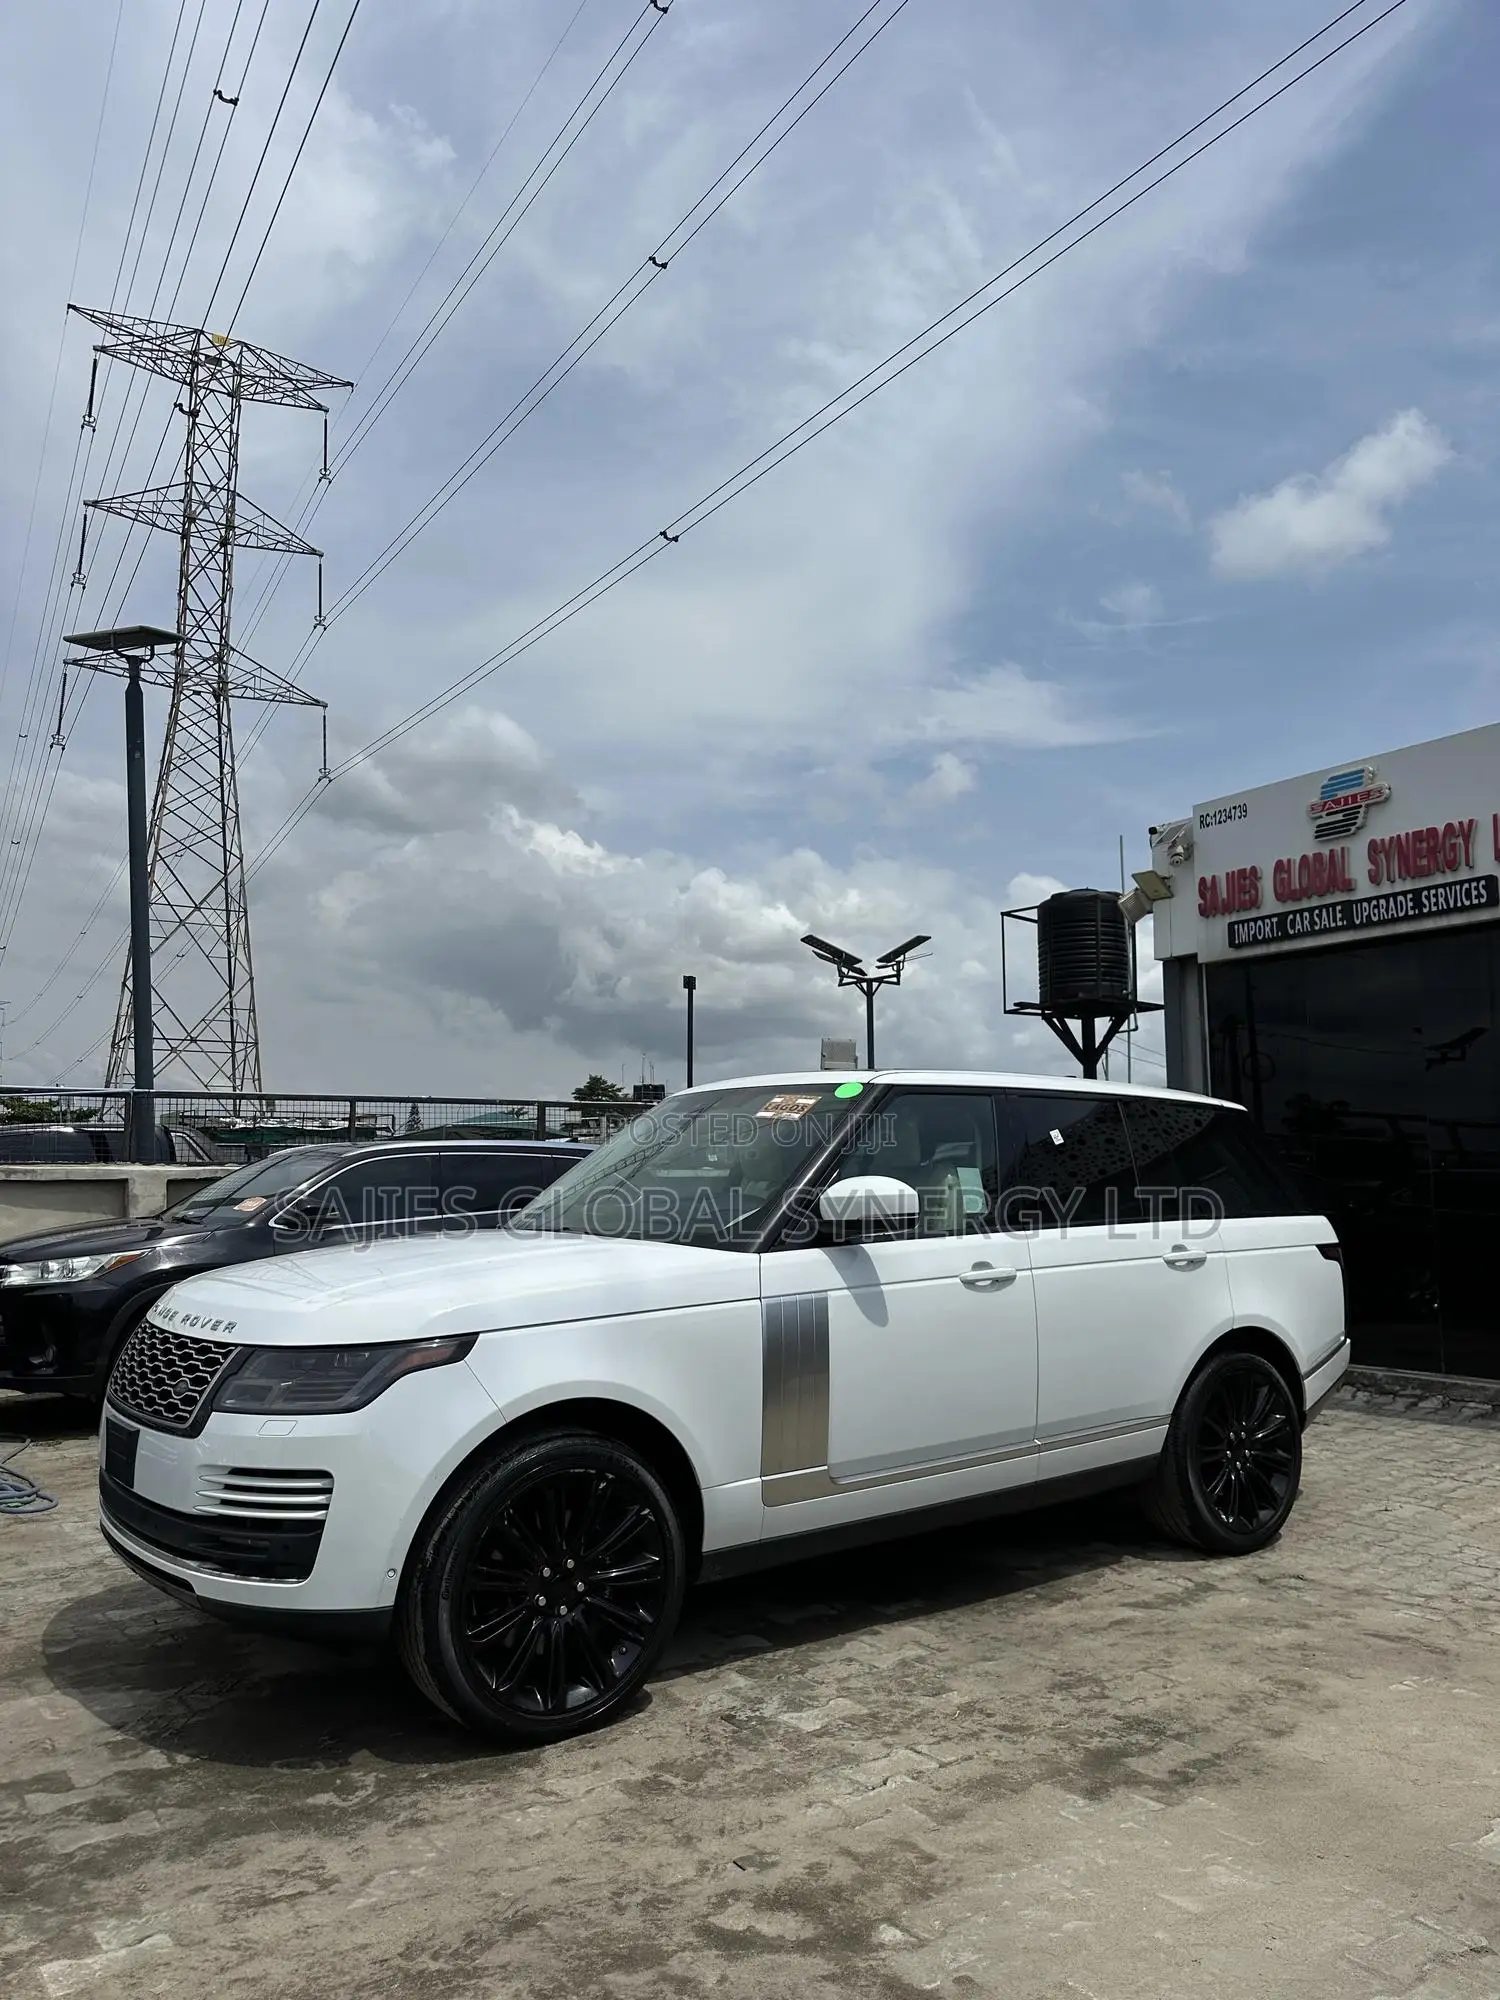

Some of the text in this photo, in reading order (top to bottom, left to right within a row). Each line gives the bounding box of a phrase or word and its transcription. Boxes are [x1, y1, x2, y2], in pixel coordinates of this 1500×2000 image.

[1309, 787, 1385, 811] SAJIES
[1199, 802, 1248, 830] RC:1234739
[1198, 865, 1261, 918] SAJIES
[1273, 847, 1356, 903] GLOBAL
[1367, 818, 1476, 886] SYNERGY
[1234, 880, 1487, 944] IMPORT. CAR SALE. UPGRADE. SERVICES
[764, 1103, 808, 1112] LAGOS
[181, 1313, 238, 1333] ROVER
